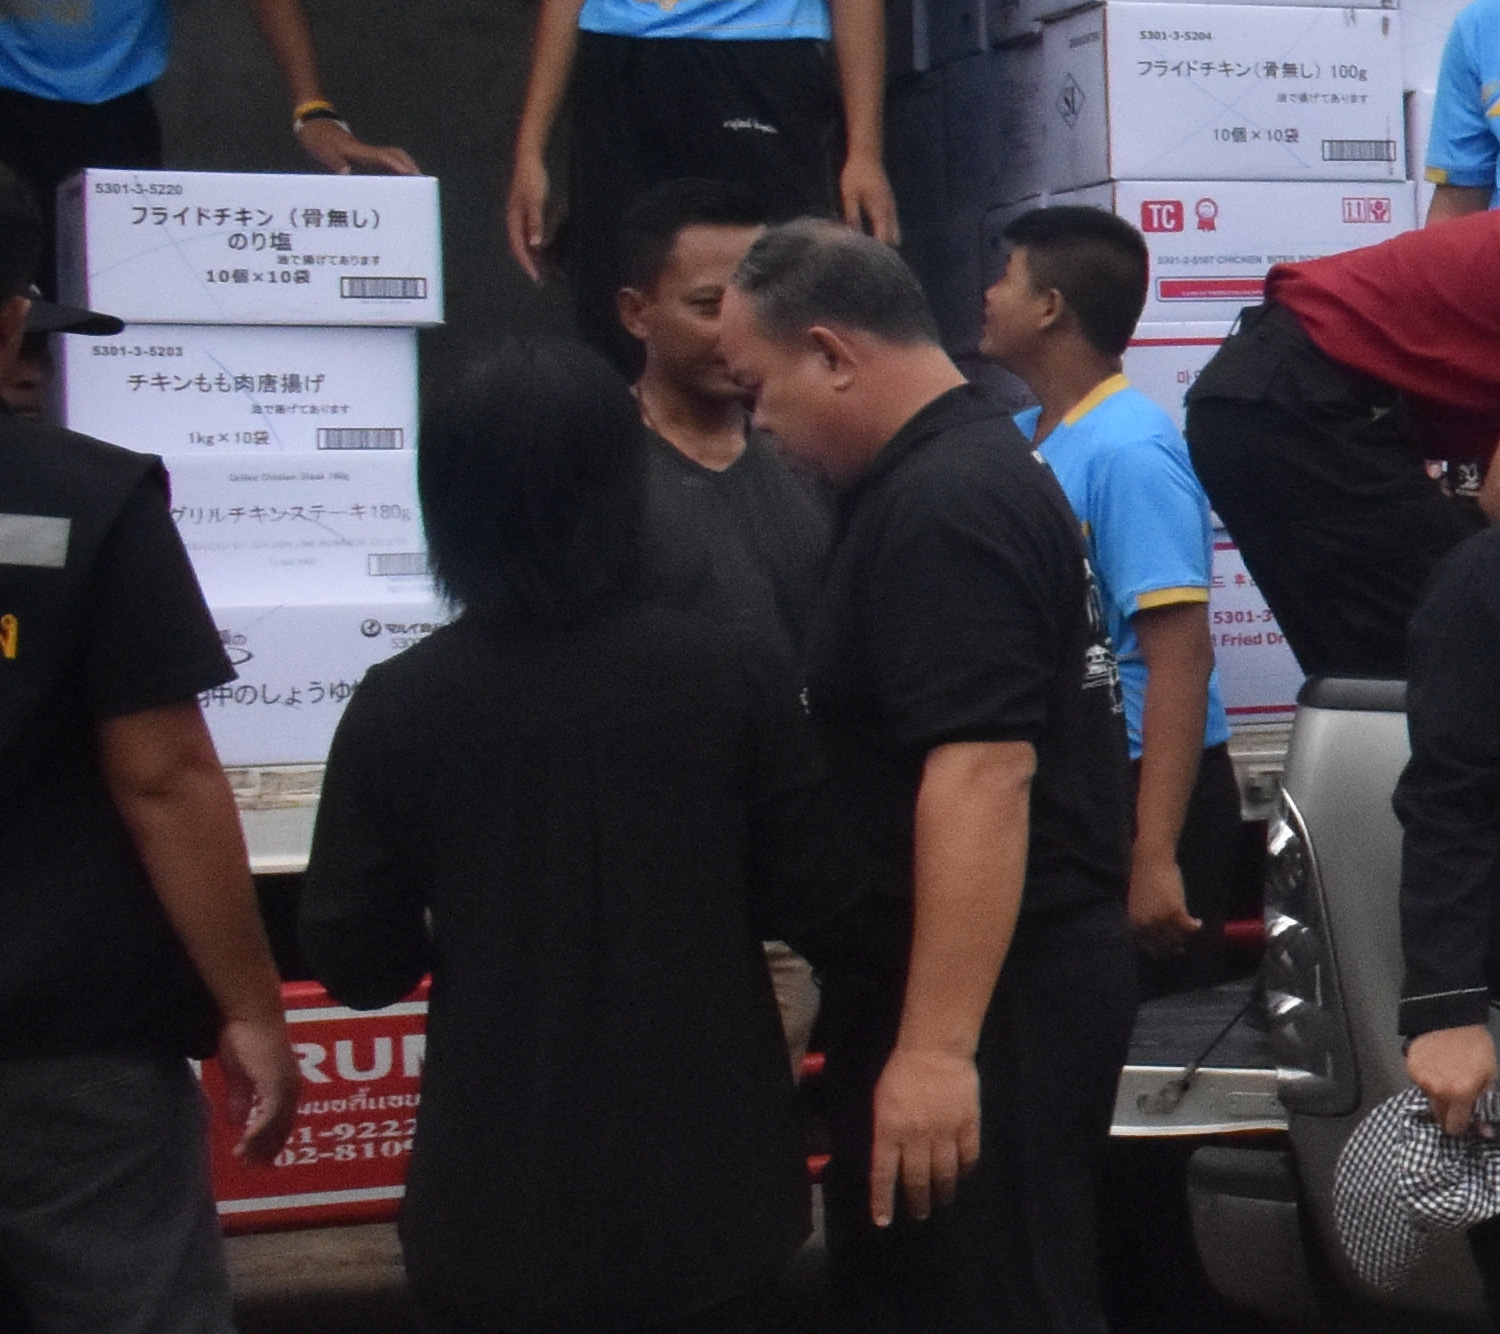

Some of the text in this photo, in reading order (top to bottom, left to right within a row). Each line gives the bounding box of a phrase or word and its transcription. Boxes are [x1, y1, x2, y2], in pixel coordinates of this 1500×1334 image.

[1148, 204, 1176, 229] TC
[228, 232, 293, 251] のり塩
[127, 373, 325, 394] チキンもも肉唐揚げ
[1221, 633, 1262, 647] Fried
